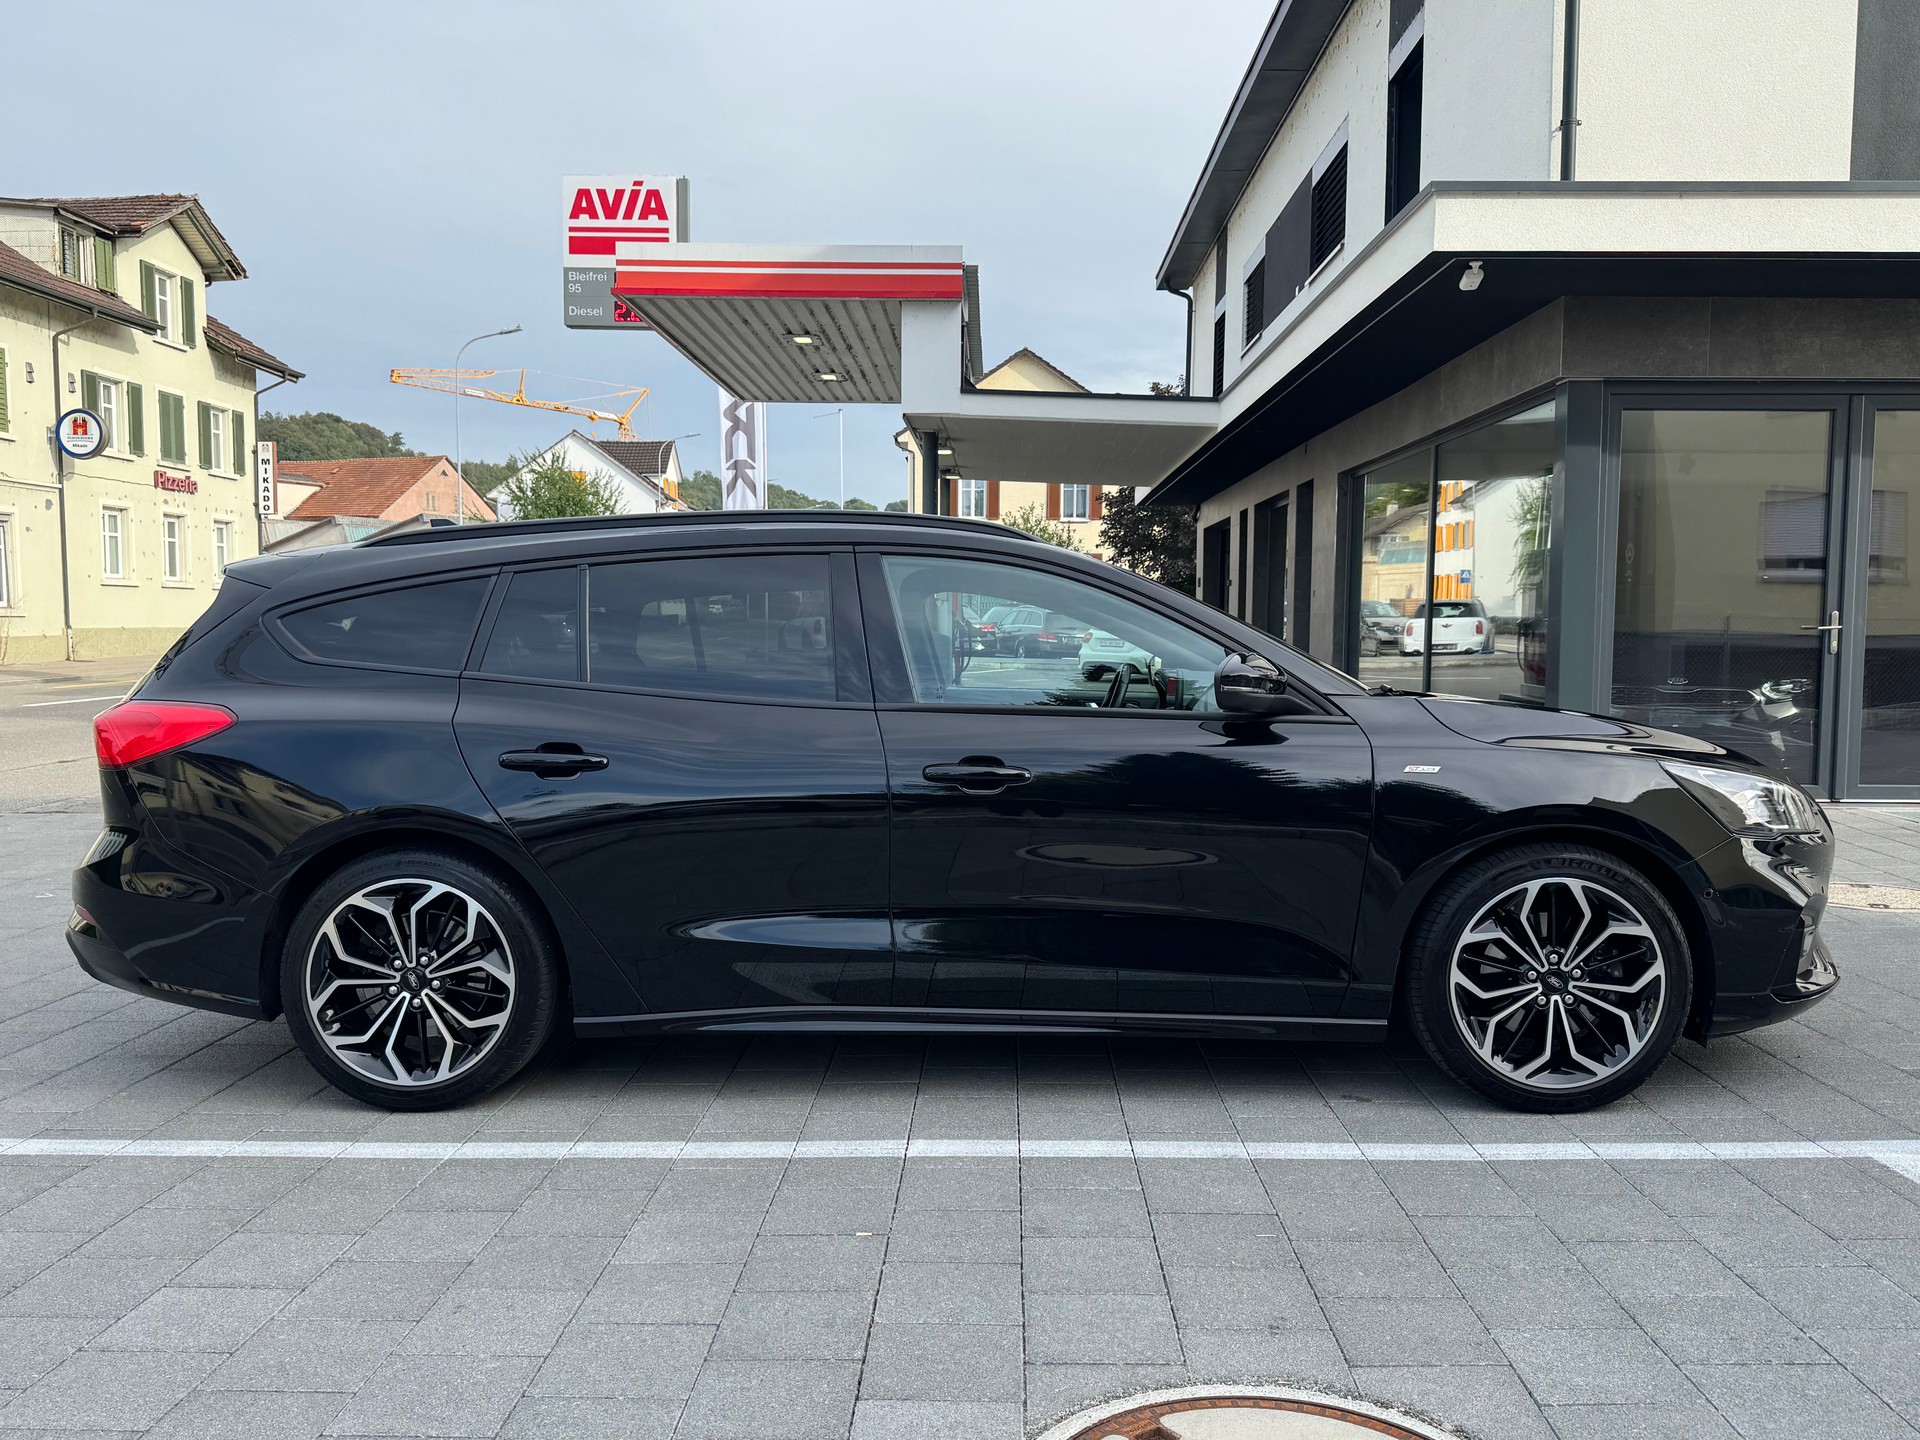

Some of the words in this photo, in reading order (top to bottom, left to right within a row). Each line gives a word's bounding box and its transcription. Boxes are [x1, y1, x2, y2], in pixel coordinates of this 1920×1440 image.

[568, 271, 607, 282] Bleifrei
[568, 283, 582, 293] 95
[568, 306, 603, 316] Diesel
[155, 470, 199, 493] Pizzeria
[261, 458, 270, 512] MIKADO
